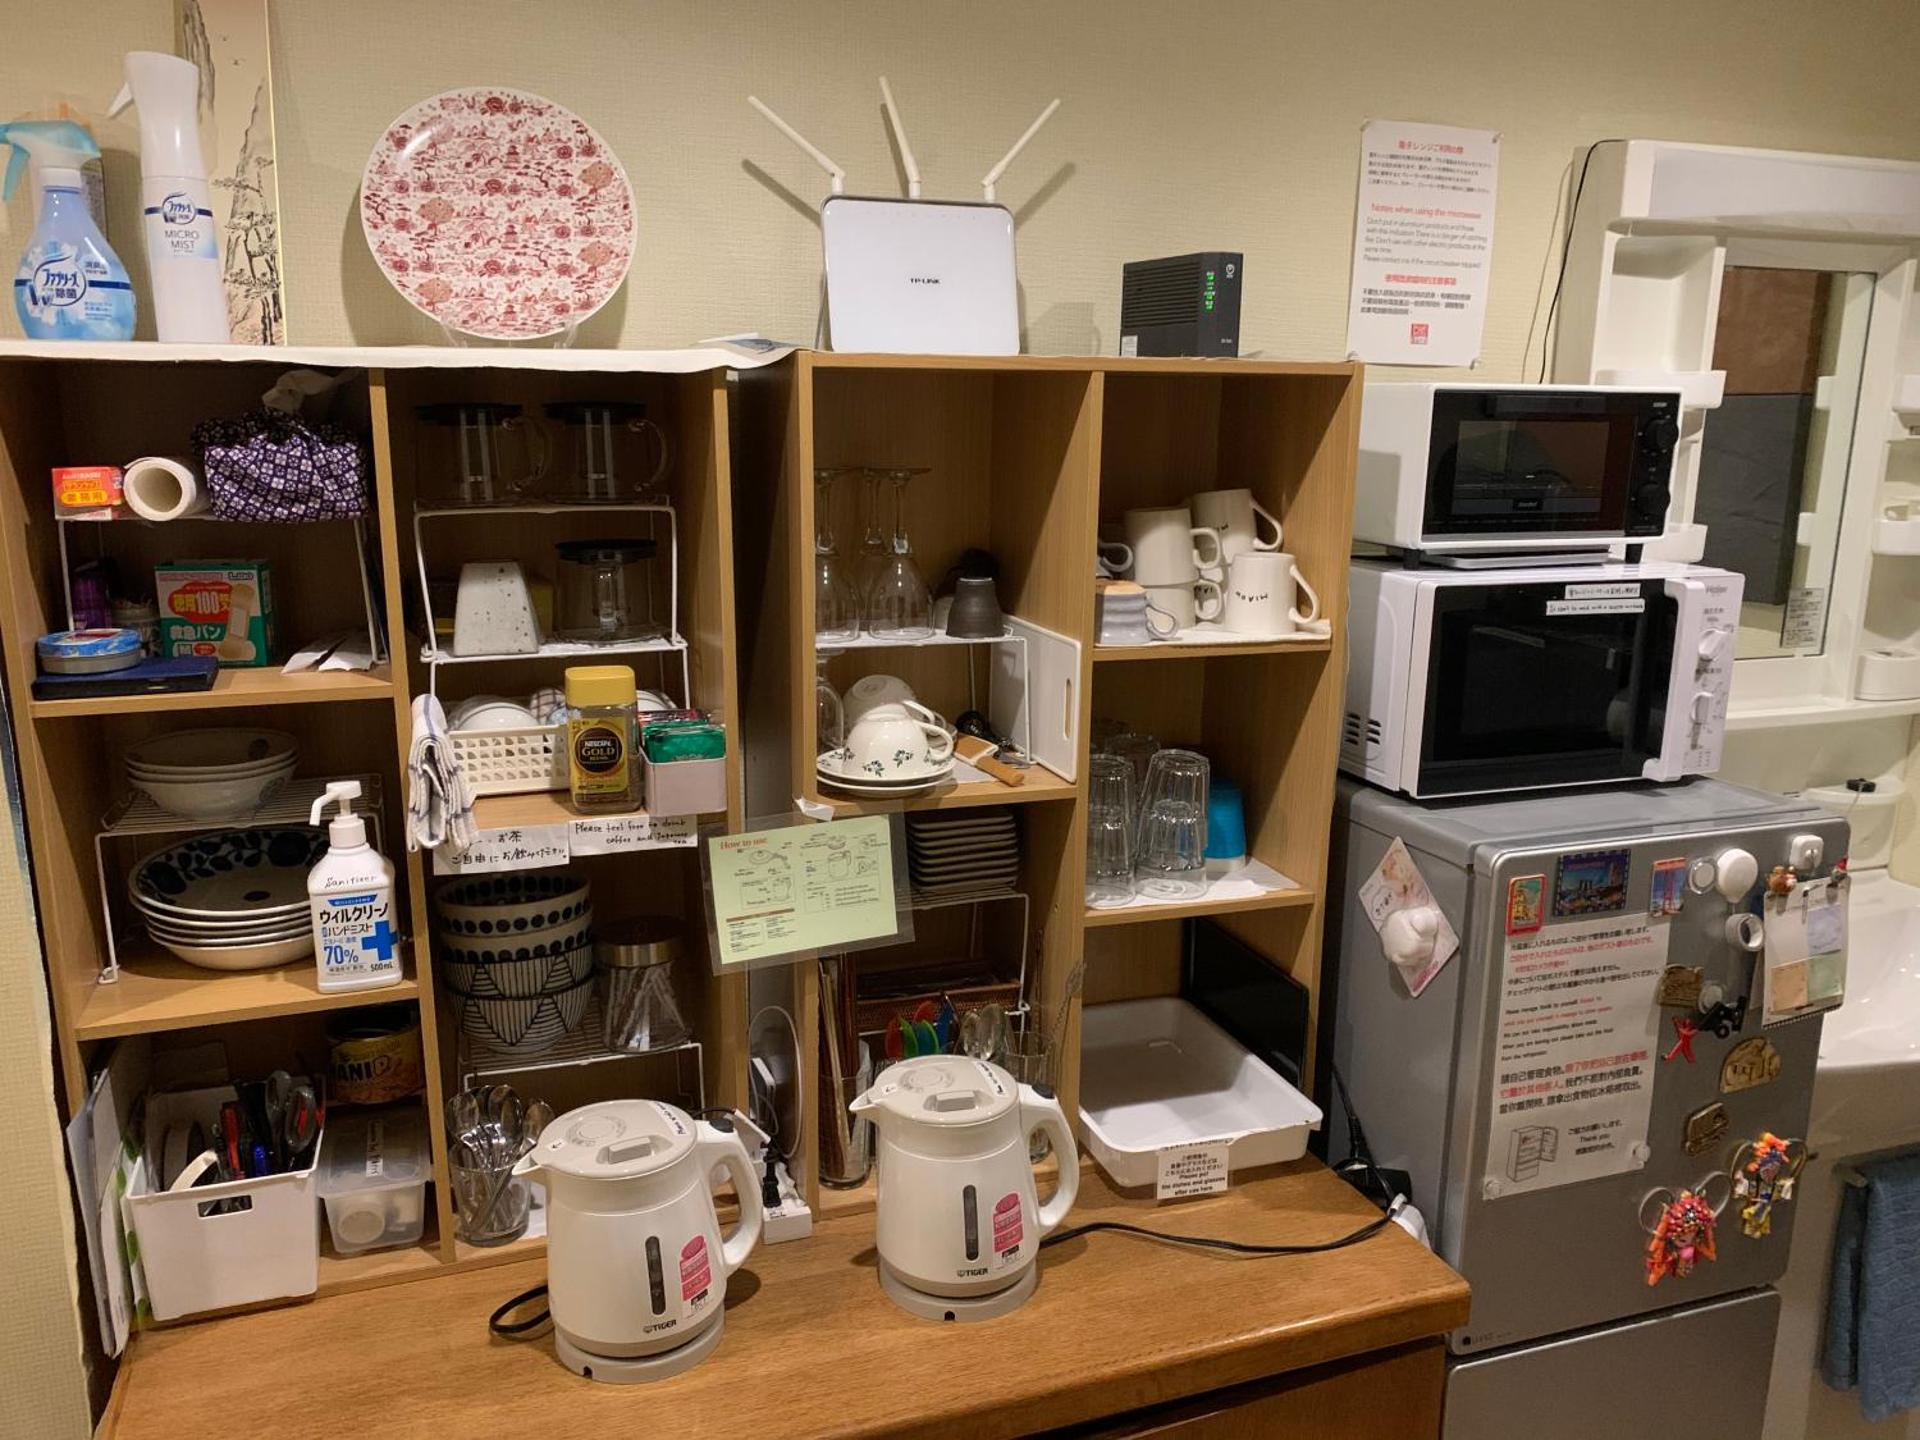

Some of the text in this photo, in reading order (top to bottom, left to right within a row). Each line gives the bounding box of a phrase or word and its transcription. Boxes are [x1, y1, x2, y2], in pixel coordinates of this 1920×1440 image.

[165, 229, 199, 240] MICRO
[171, 240, 196, 250] MIST
[42, 268, 80, 288] ファブリーズ
[55, 288, 77, 299] 除菌
[582, 747, 615, 757] GOLD
[575, 822, 603, 834] Please
[606, 835, 632, 846] coffee
[637, 834, 653, 842] and
[720, 838, 768, 850] How to use
[324, 944, 359, 966] 70%
[965, 1267, 989, 1278] TIGER
[652, 1318, 677, 1332] TIGER
